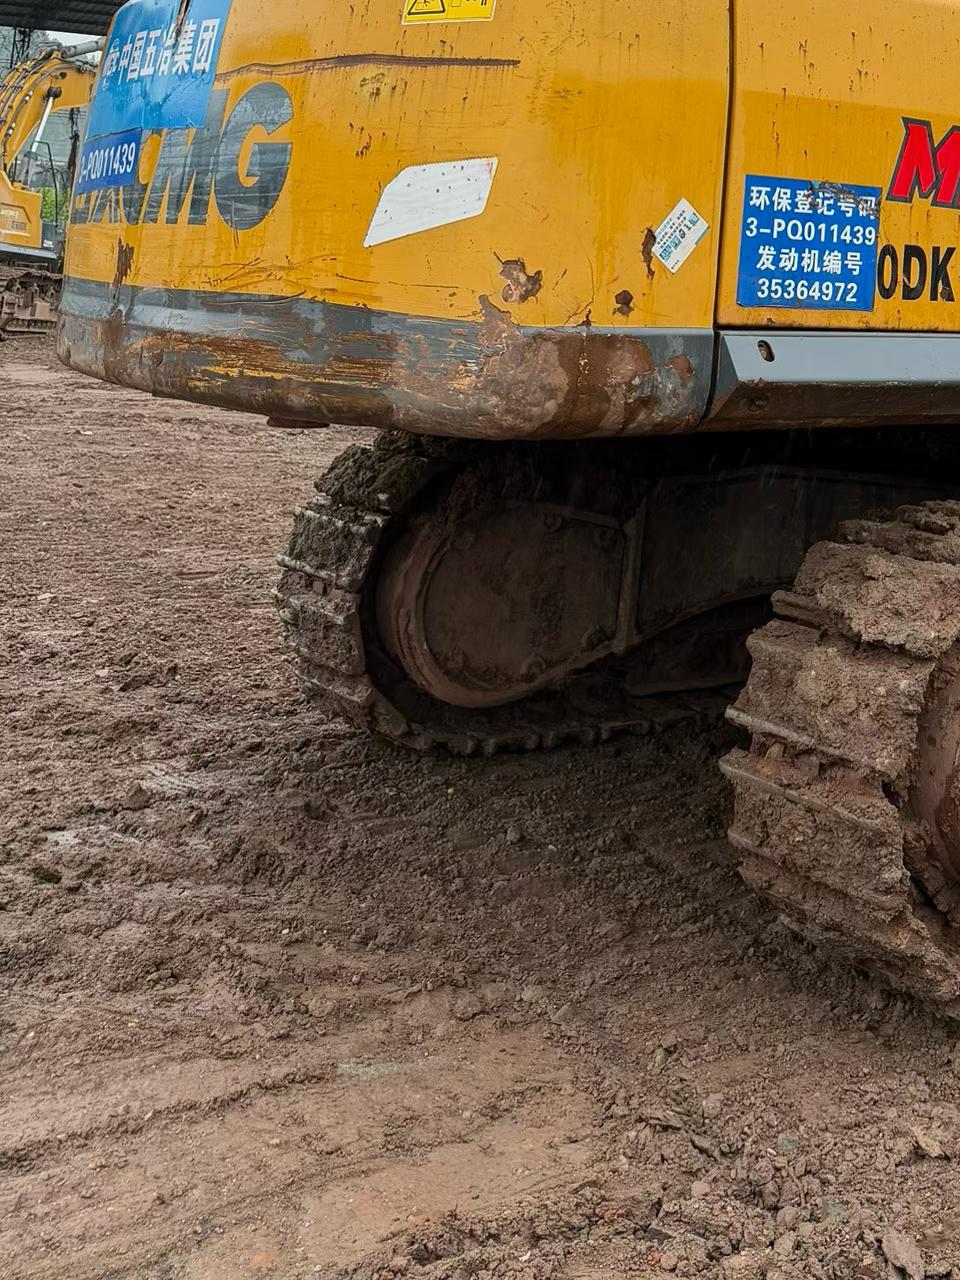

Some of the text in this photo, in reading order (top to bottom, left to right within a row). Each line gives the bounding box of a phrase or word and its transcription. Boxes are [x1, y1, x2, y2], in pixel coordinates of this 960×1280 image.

[118, 18, 220, 84] 中国五冶集团
[749, 186, 877, 219] 环保登记号码
[745, 217, 876, 246] 3-PQ011439
[755, 245, 862, 276] 发动机编号
[757, 278, 858, 302] 35364972
